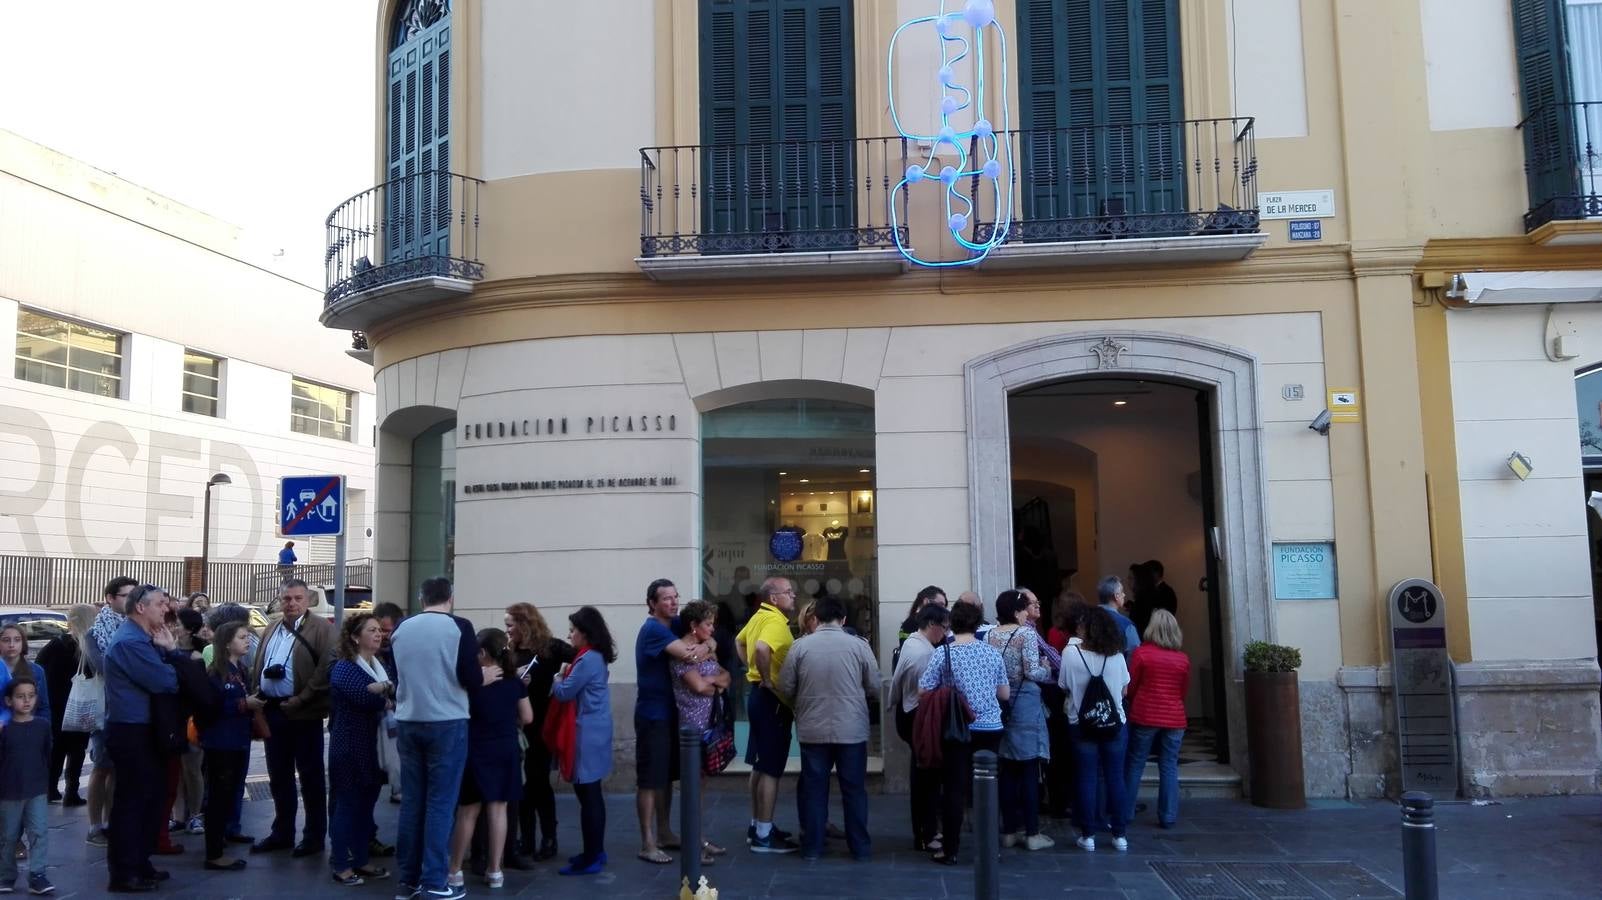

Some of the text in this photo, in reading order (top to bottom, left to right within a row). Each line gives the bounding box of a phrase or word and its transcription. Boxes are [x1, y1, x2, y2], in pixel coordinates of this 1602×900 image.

[1266, 196, 1282, 204] PLAZA
[1266, 203, 1317, 214] DE LA MERCED
[586, 414, 676, 434] PICASSO
[1281, 553, 1324, 563] PICASSO
